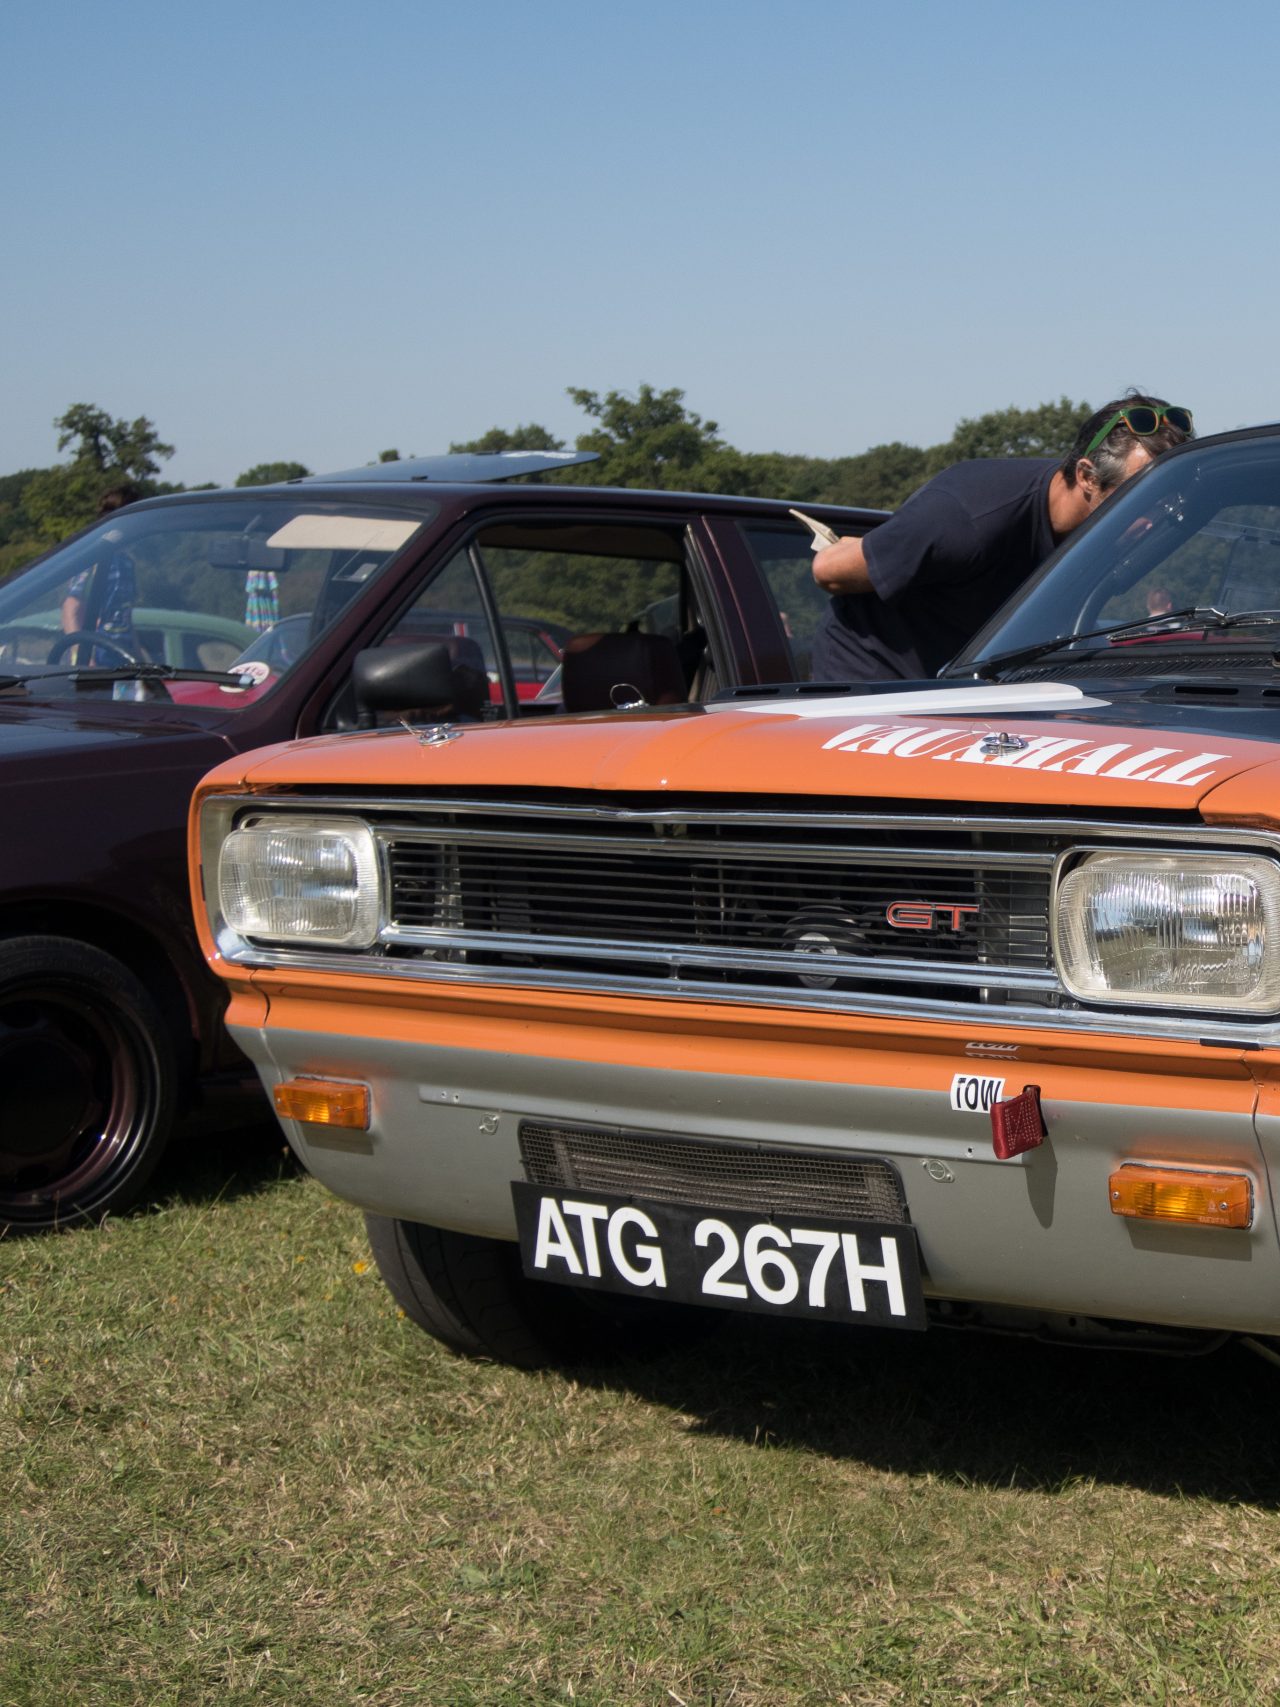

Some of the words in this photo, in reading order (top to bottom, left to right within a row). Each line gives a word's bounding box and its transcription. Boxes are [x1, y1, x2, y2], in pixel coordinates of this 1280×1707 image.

[821, 723, 1232, 786] VAUXHALL
[886, 901, 979, 931] GT
[956, 1077, 1001, 1112] TOW
[534, 1197, 668, 1288] ATG
[694, 1218, 906, 1317] 267H
